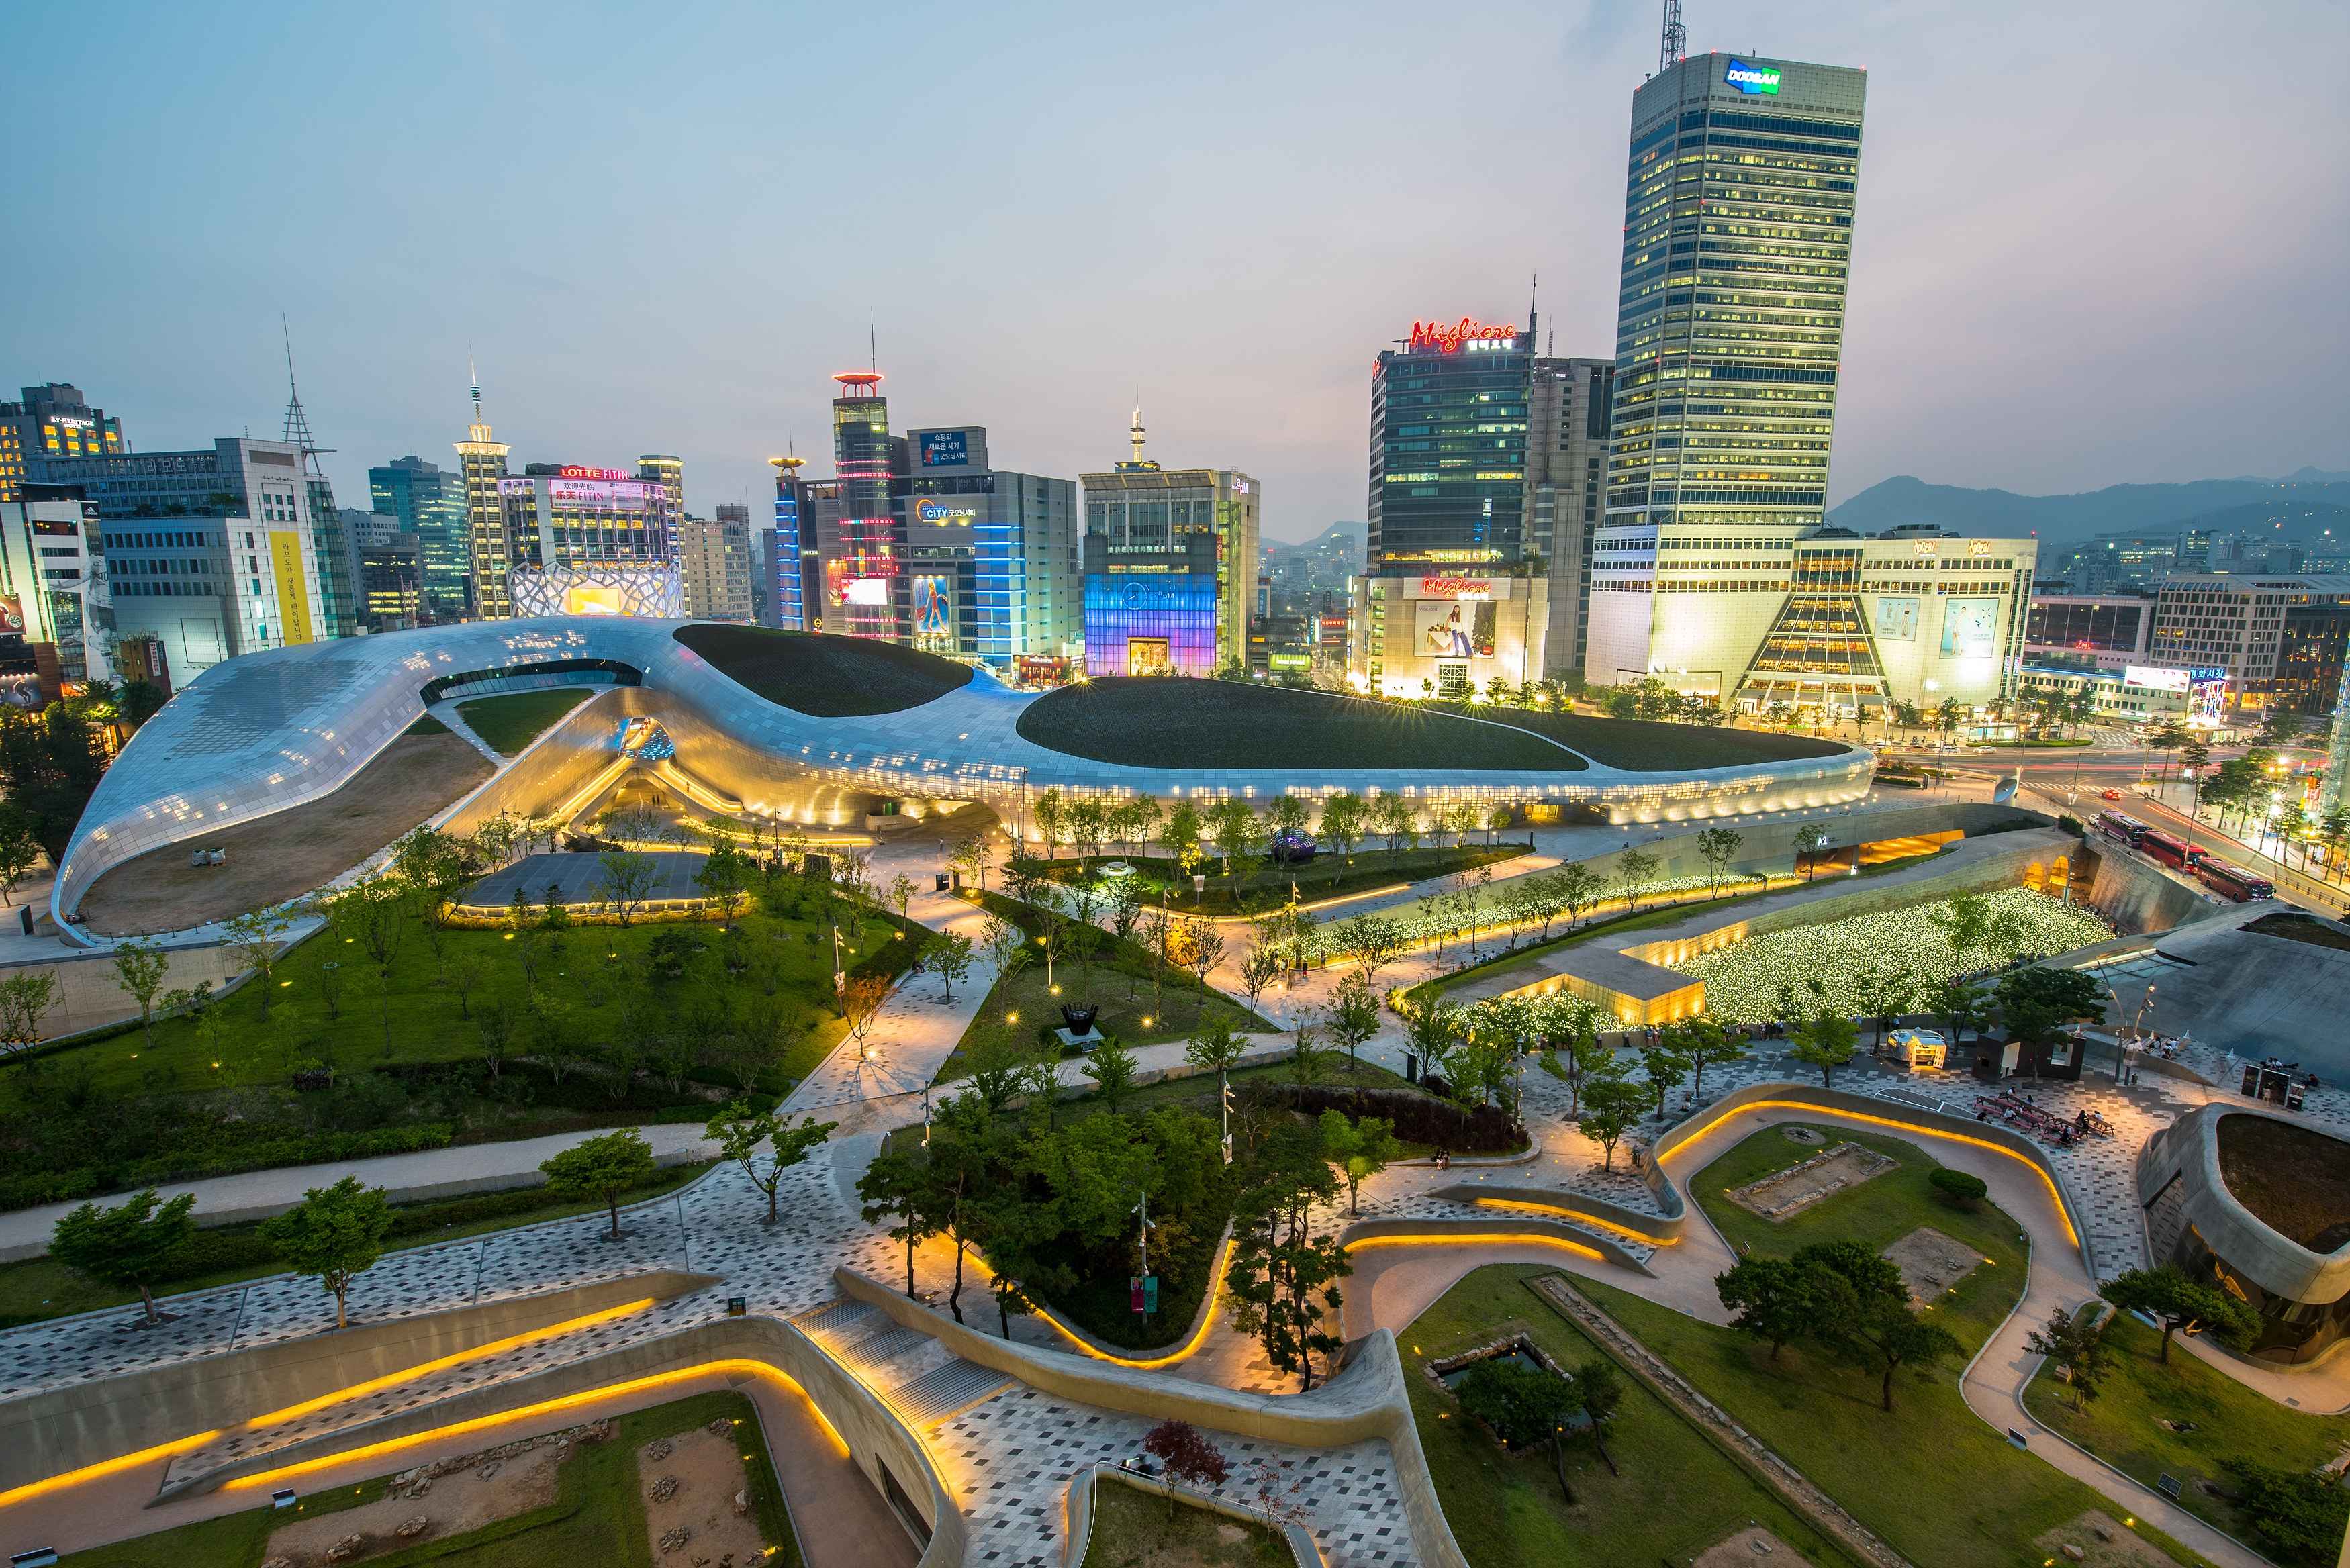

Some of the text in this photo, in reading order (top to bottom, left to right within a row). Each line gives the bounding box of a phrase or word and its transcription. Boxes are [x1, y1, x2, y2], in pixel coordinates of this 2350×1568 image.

[1410, 316, 1516, 352] Migliore
[934, 433, 952, 441] 쇼핑의
[948, 442, 960, 450] 세계
[939, 452, 967, 460] 굿모닝시티
[561, 468, 628, 479] LOTTE FITIN
[563, 483, 594, 491] 欢迎光临
[927, 509, 947, 518] CITY
[1423, 578, 1490, 599] Migliore
